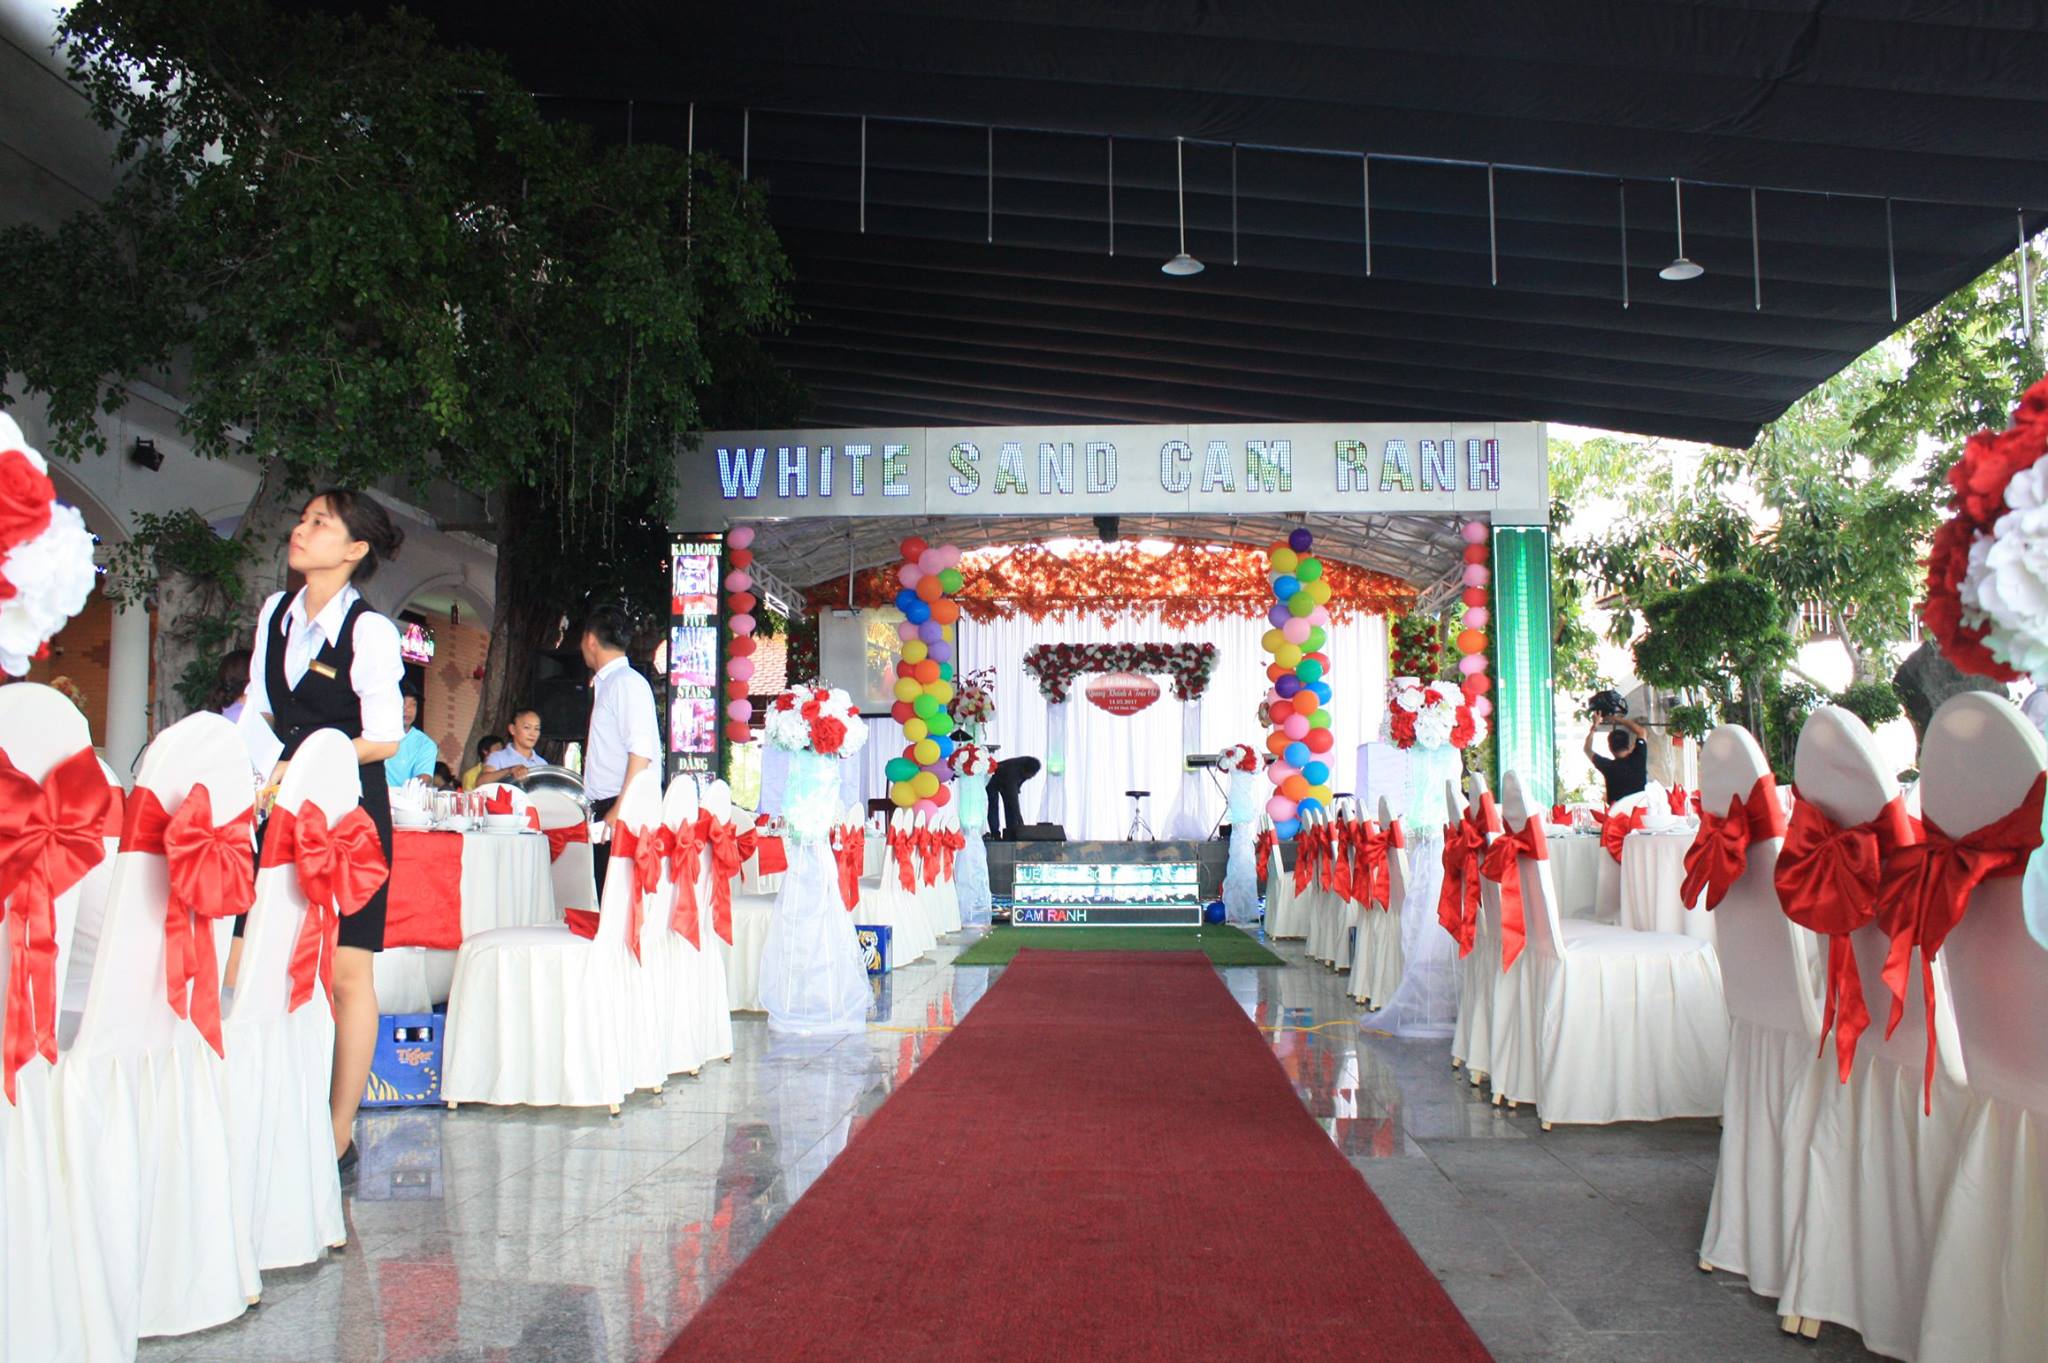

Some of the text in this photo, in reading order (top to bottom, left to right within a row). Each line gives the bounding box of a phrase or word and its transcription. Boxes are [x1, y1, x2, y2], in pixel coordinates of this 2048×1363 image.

[716, 438, 1501, 499] WHITE SAND CAM RANH
[671, 543, 722, 556] KARAOKE
[683, 614, 707, 627] FIVE
[677, 686, 711, 699] STARS
[1015, 909, 1087, 922] CAM RANH
[396, 1048, 433, 1066] Tiger
